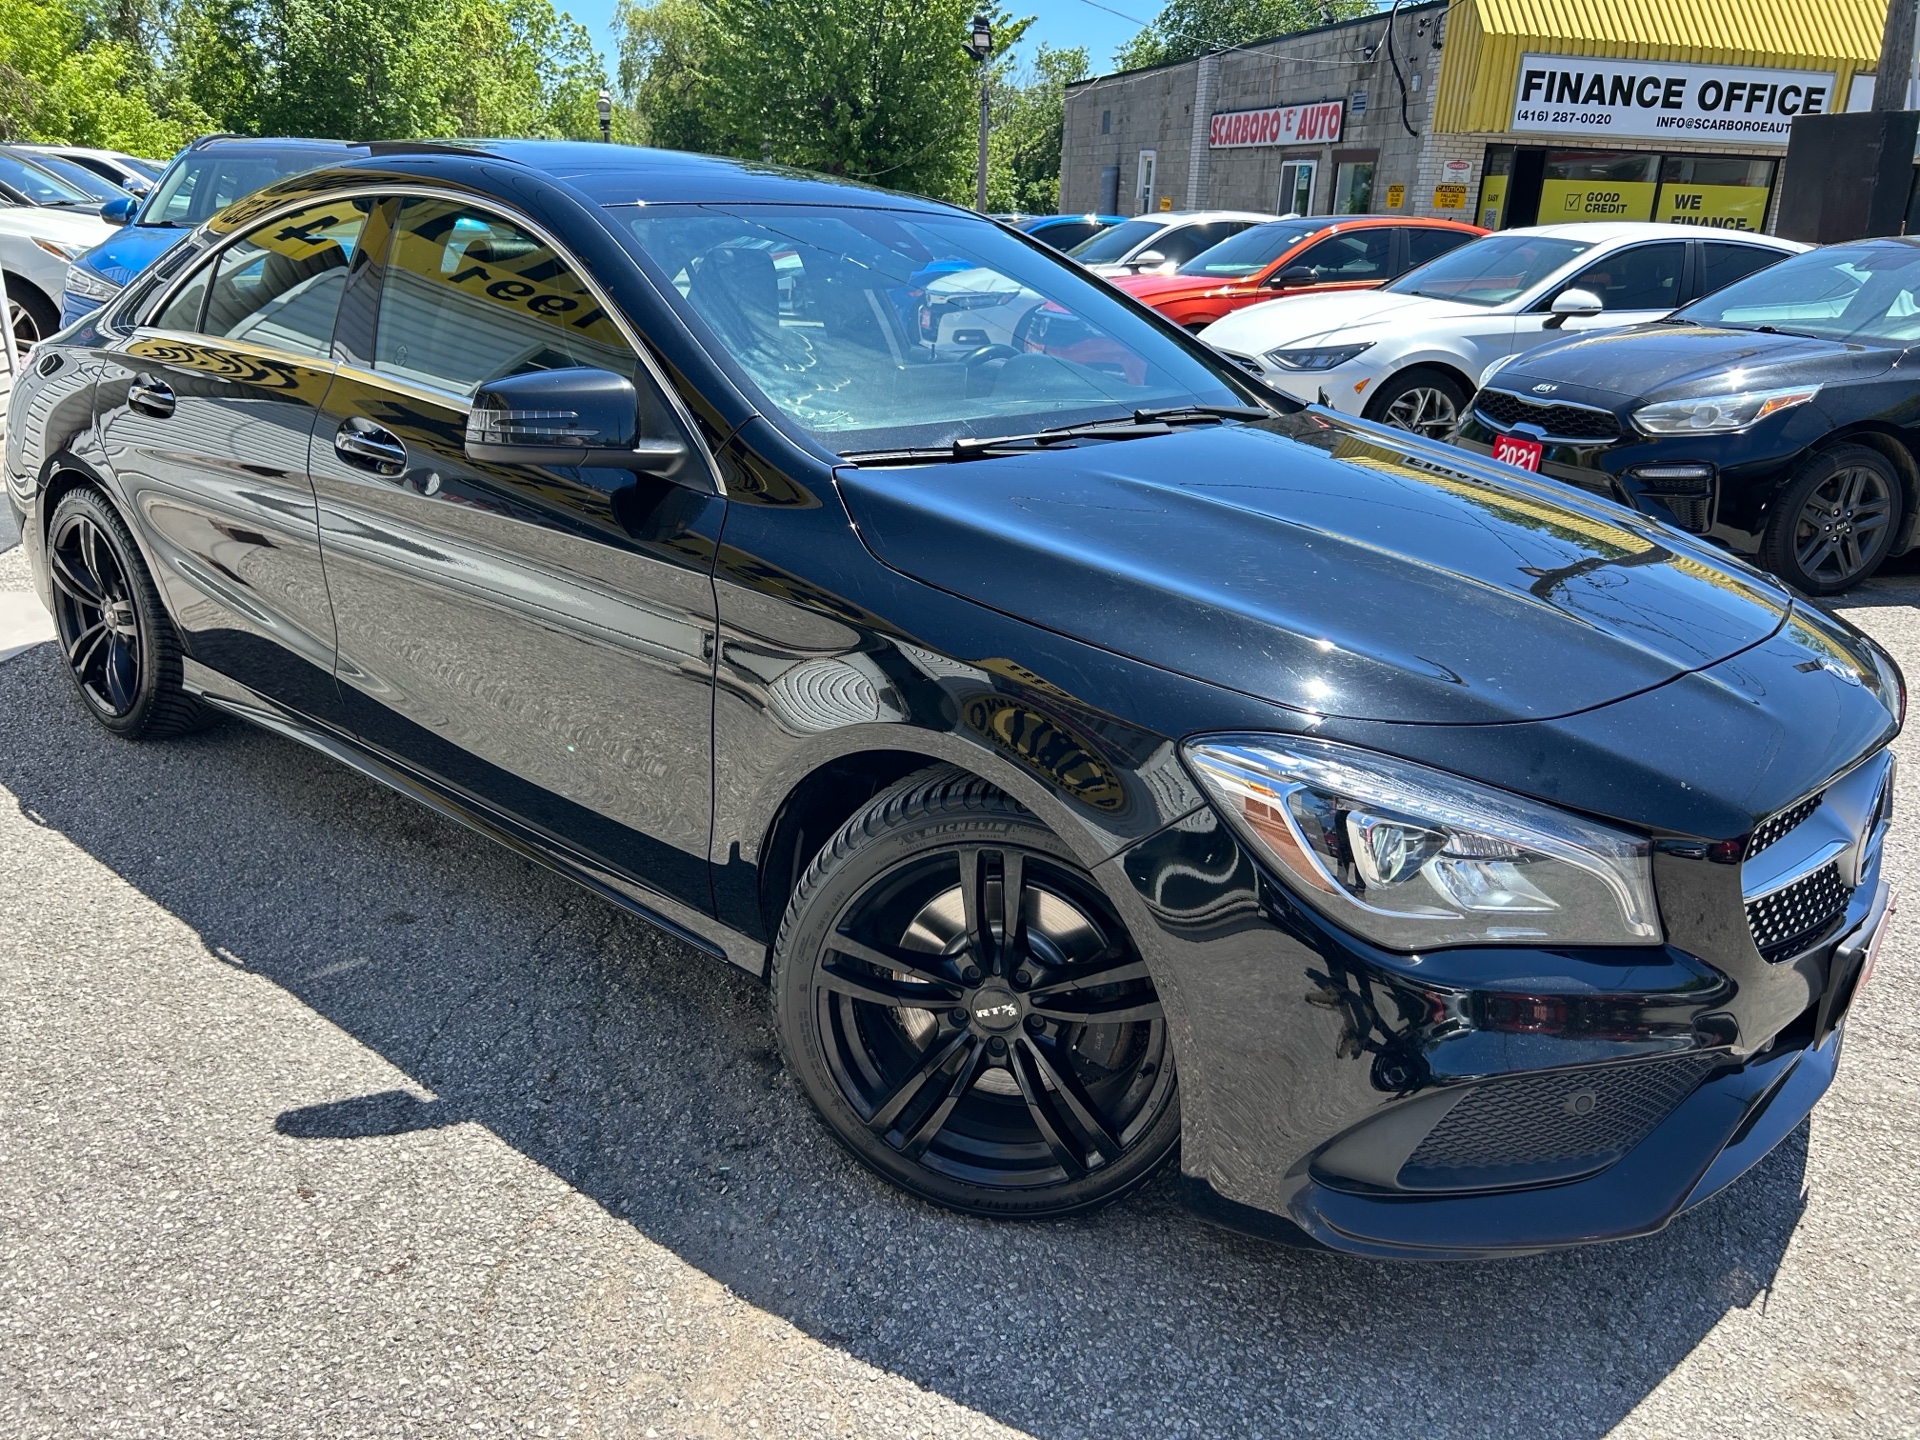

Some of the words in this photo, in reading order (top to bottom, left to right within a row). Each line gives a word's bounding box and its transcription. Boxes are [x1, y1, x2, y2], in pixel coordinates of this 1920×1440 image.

[1521, 69, 1687, 109] FINANCE
[1697, 79, 1827, 116] OFFICE
[1209, 110, 1281, 145] SCARBORO
[1295, 103, 1341, 141] AUTO
[1517, 110, 1549, 122] (416)
[1552, 111, 1612, 125] 287-0020
[1586, 192, 1620, 203] GOOD
[1674, 194, 1702, 210] WE
[1585, 204, 1627, 214] CREDIT
[1497, 444, 1536, 472] 2021
[1836, 521, 1848, 530] KIA
[924, 822, 1007, 837] MICHELIN
